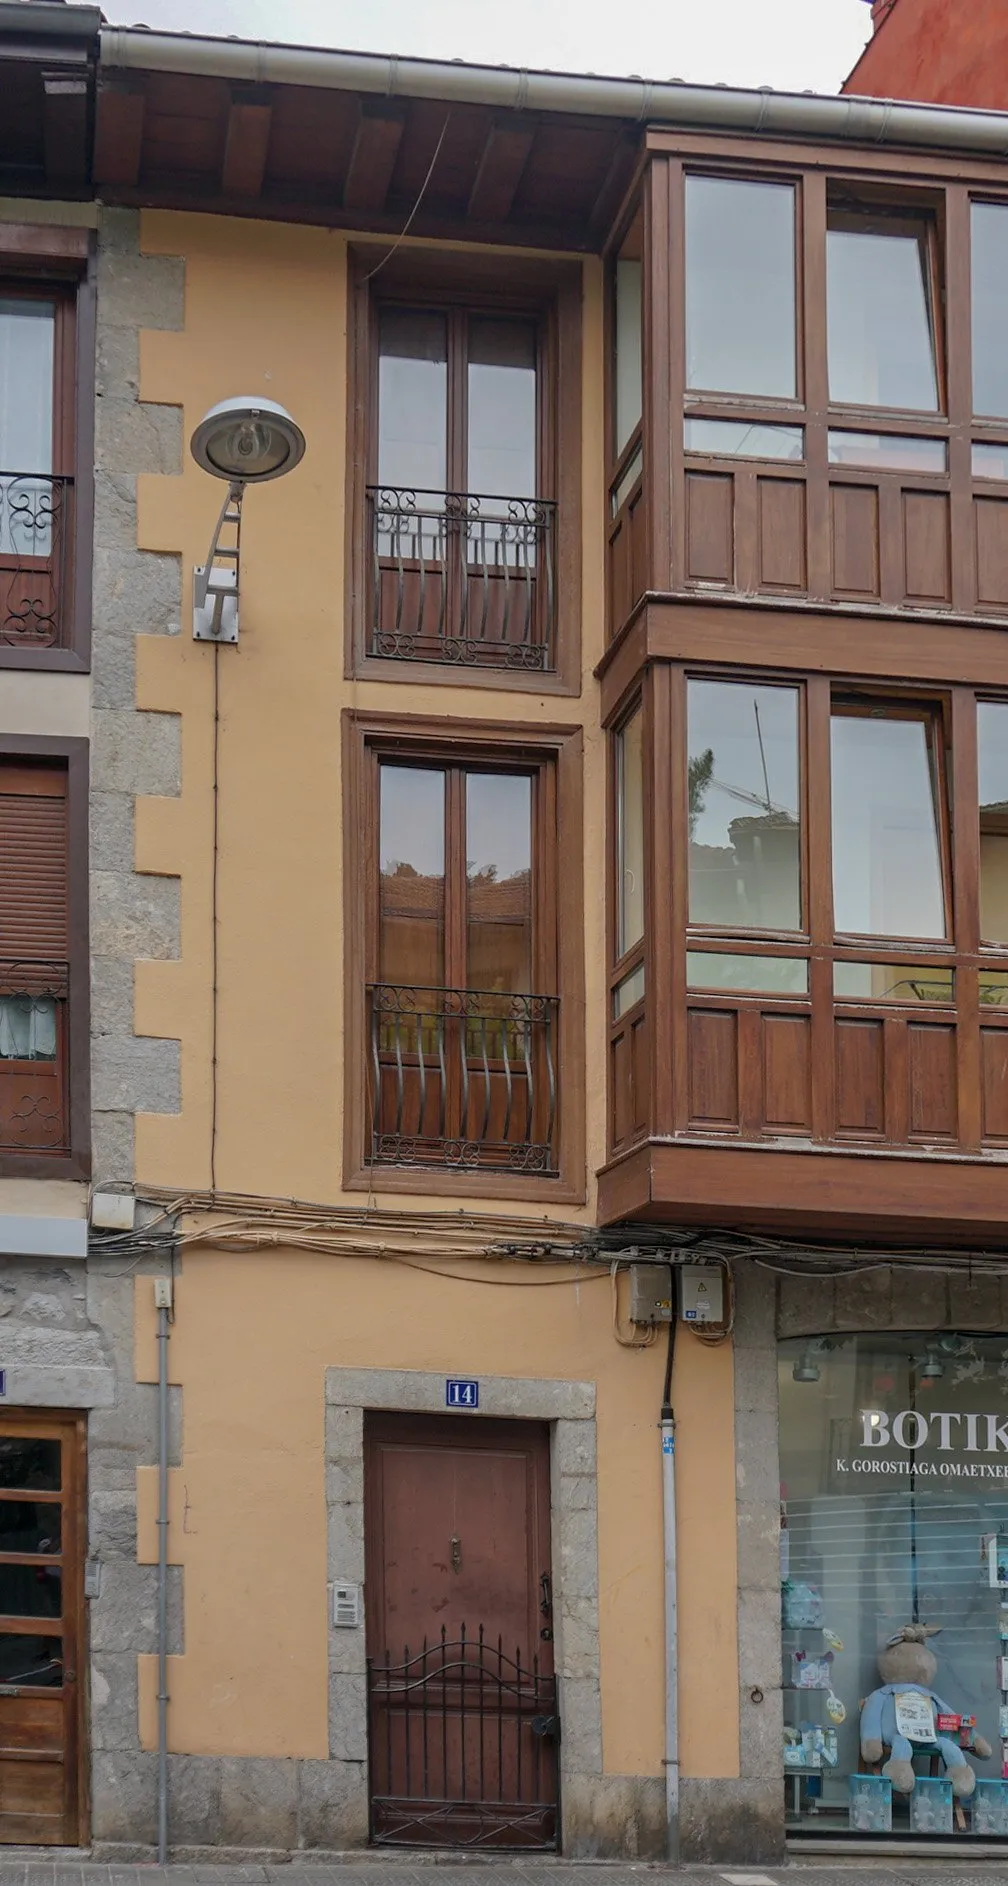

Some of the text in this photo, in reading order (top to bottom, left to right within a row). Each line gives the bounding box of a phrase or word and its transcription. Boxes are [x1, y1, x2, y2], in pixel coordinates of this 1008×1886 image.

[452, 1384, 473, 1404] 14
[836, 1459, 850, 1472] K.
[852, 1459, 938, 1476] GOROSTIAGA
